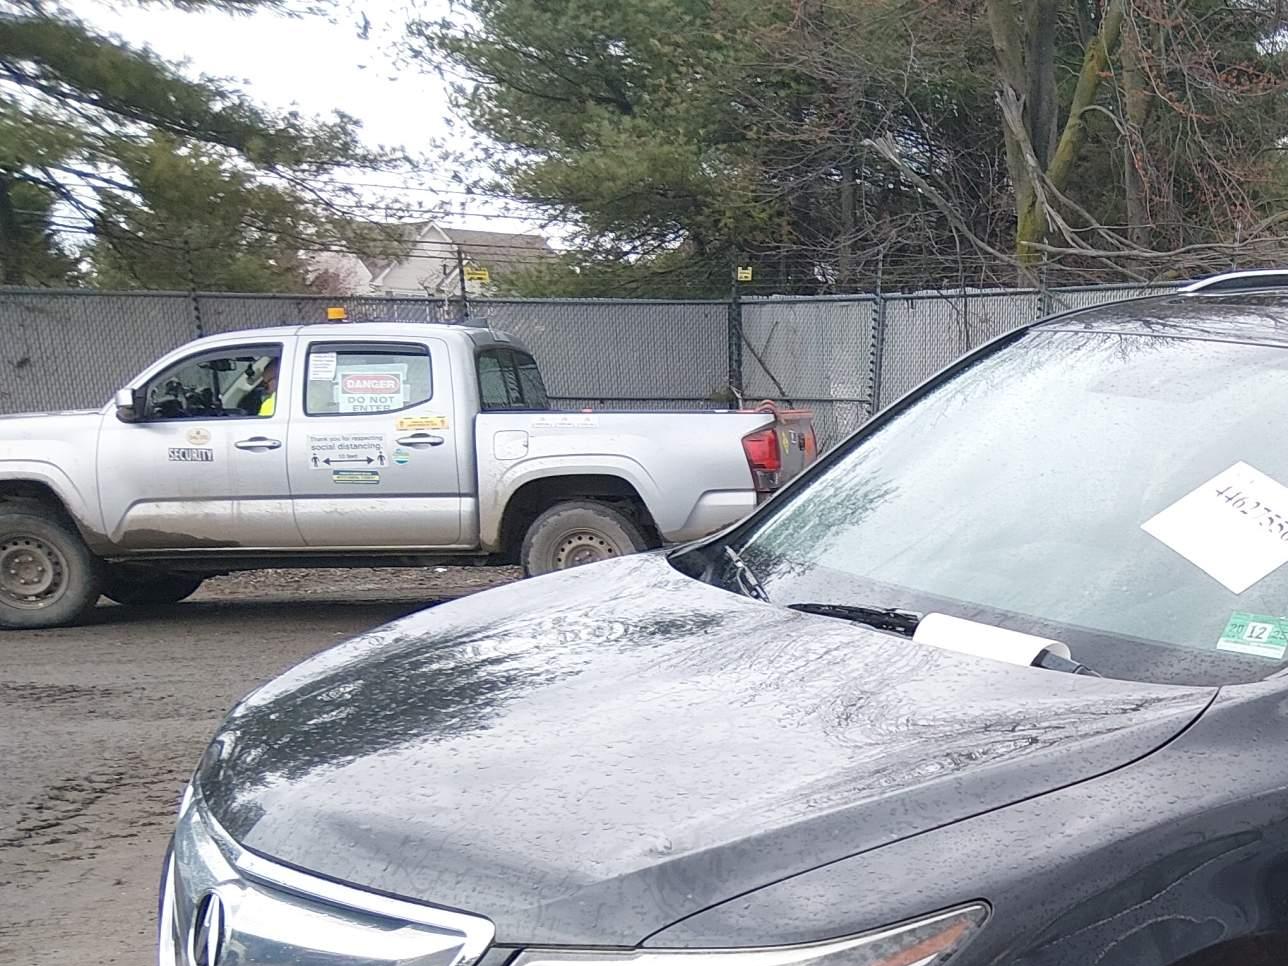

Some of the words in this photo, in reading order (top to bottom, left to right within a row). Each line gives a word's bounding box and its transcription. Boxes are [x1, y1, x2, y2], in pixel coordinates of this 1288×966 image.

[346, 379, 396, 389] DANGER
[347, 396, 366, 404] DO
[373, 396, 395, 404] NOT
[311, 443, 337, 451] social
[168, 448, 213, 461] SECURITY
[1247, 625, 1268, 640] 12
